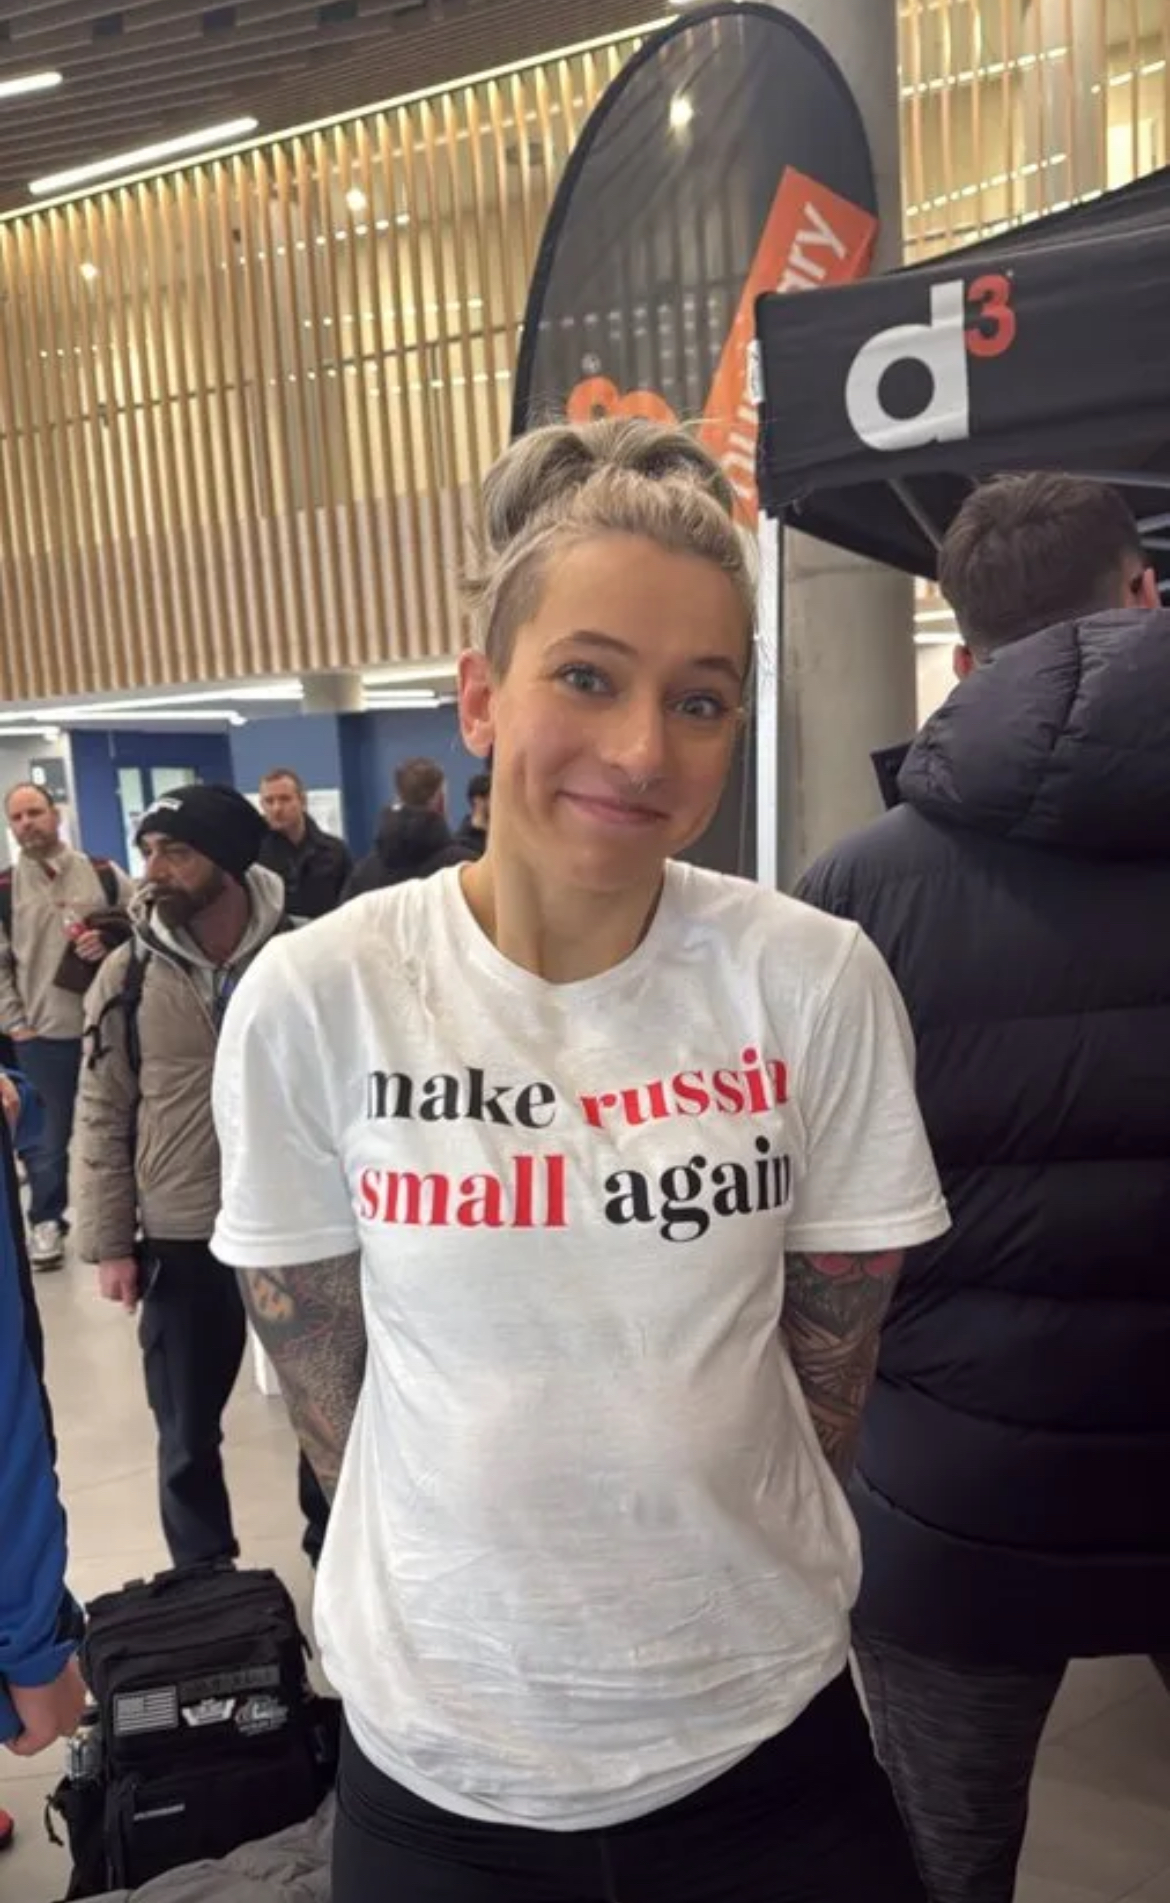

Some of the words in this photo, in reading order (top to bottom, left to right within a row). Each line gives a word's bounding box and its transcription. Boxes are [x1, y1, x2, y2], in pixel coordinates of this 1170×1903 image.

[846, 274, 1016, 451] d3
[367, 1067, 556, 1129] make
[359, 1153, 568, 1227] small
[604, 1135, 790, 1243] again
